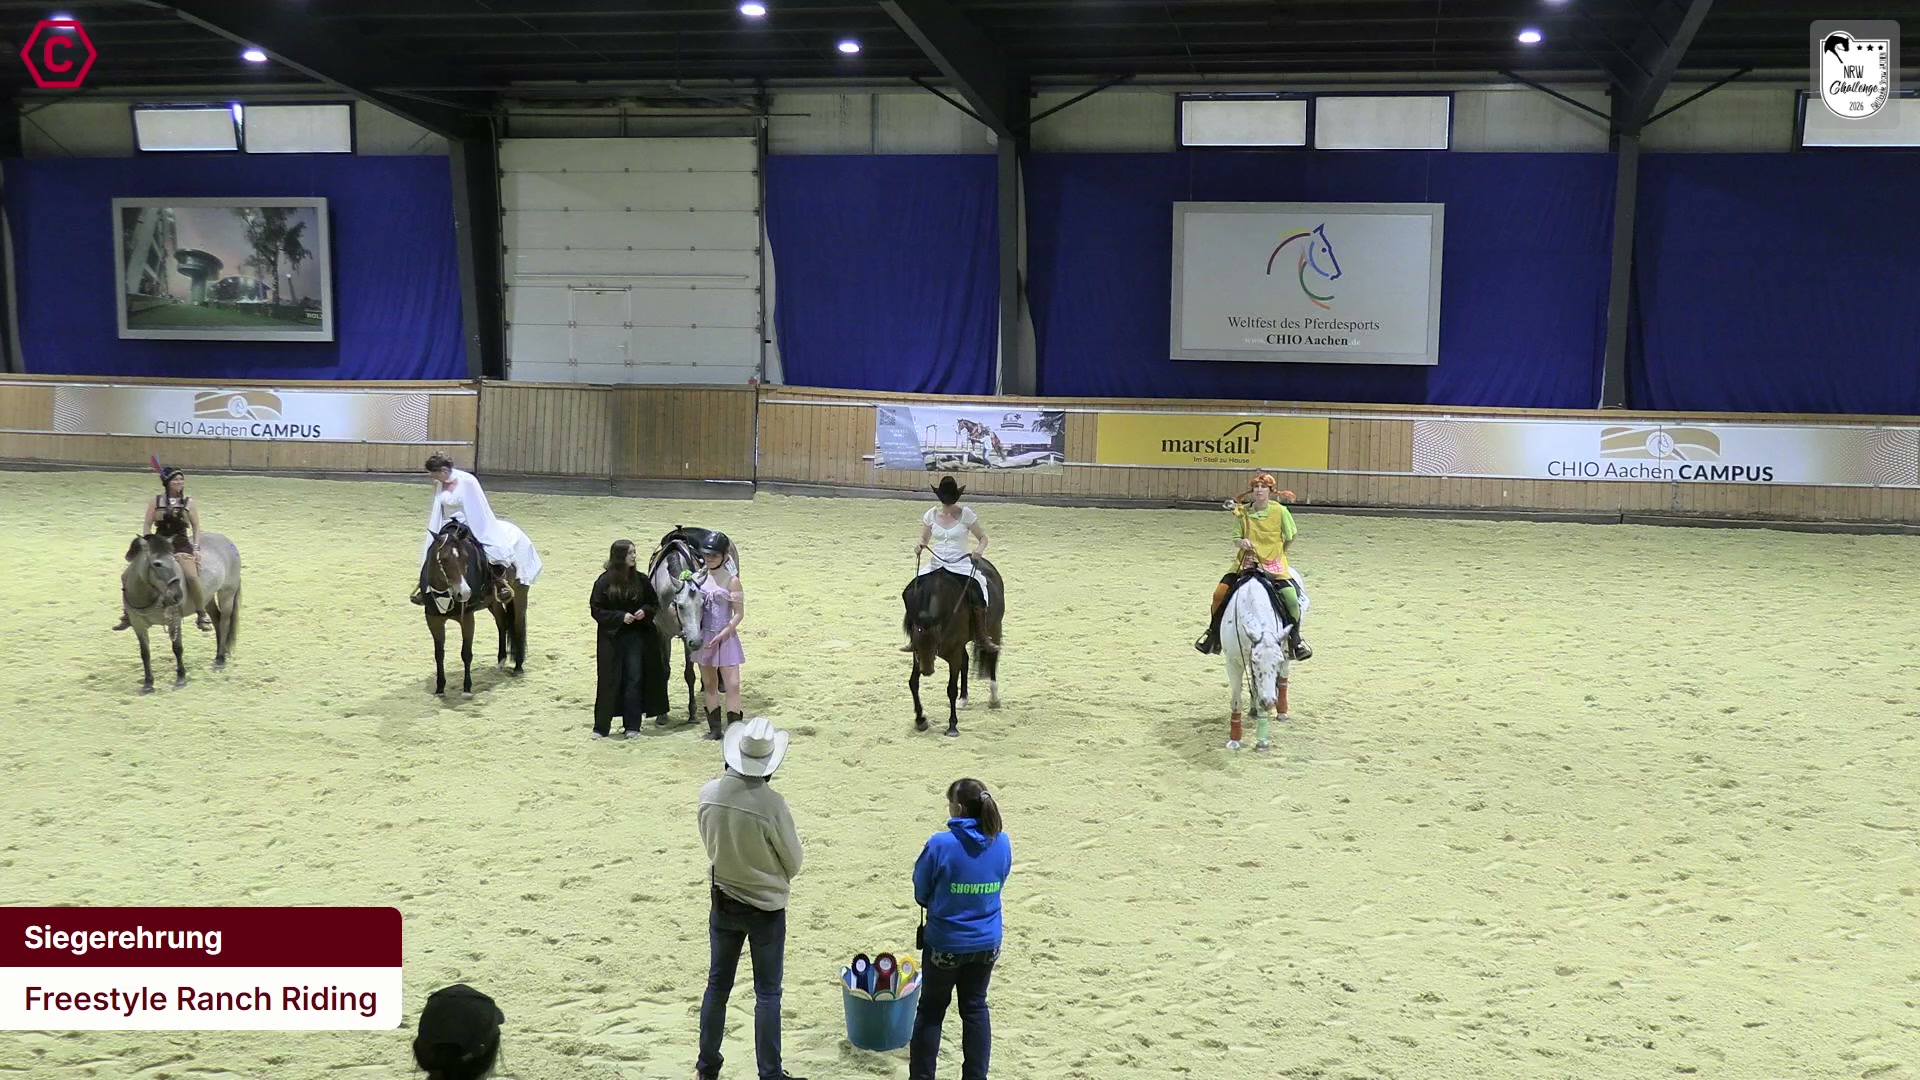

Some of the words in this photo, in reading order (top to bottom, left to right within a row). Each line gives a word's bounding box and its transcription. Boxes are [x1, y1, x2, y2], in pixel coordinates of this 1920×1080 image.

[1228, 316, 1277, 329] Weltfest
[1280, 317, 1300, 329] des
[1304, 317, 1380, 333] Pferdesports
[1266, 333, 1302, 345] CHIO
[1305, 335, 1349, 346] Aachen
[154, 420, 193, 435] CHIO
[196, 422, 247, 437] Aachen
[250, 423, 321, 438] CAMPUS
[1161, 436, 1250, 454] marstall
[1547, 460, 1600, 478] CHIO
[1604, 462, 1674, 480] Aachen
[1678, 464, 1774, 482] CAMPUS
[950, 881, 1001, 894] SHOWTEAM
